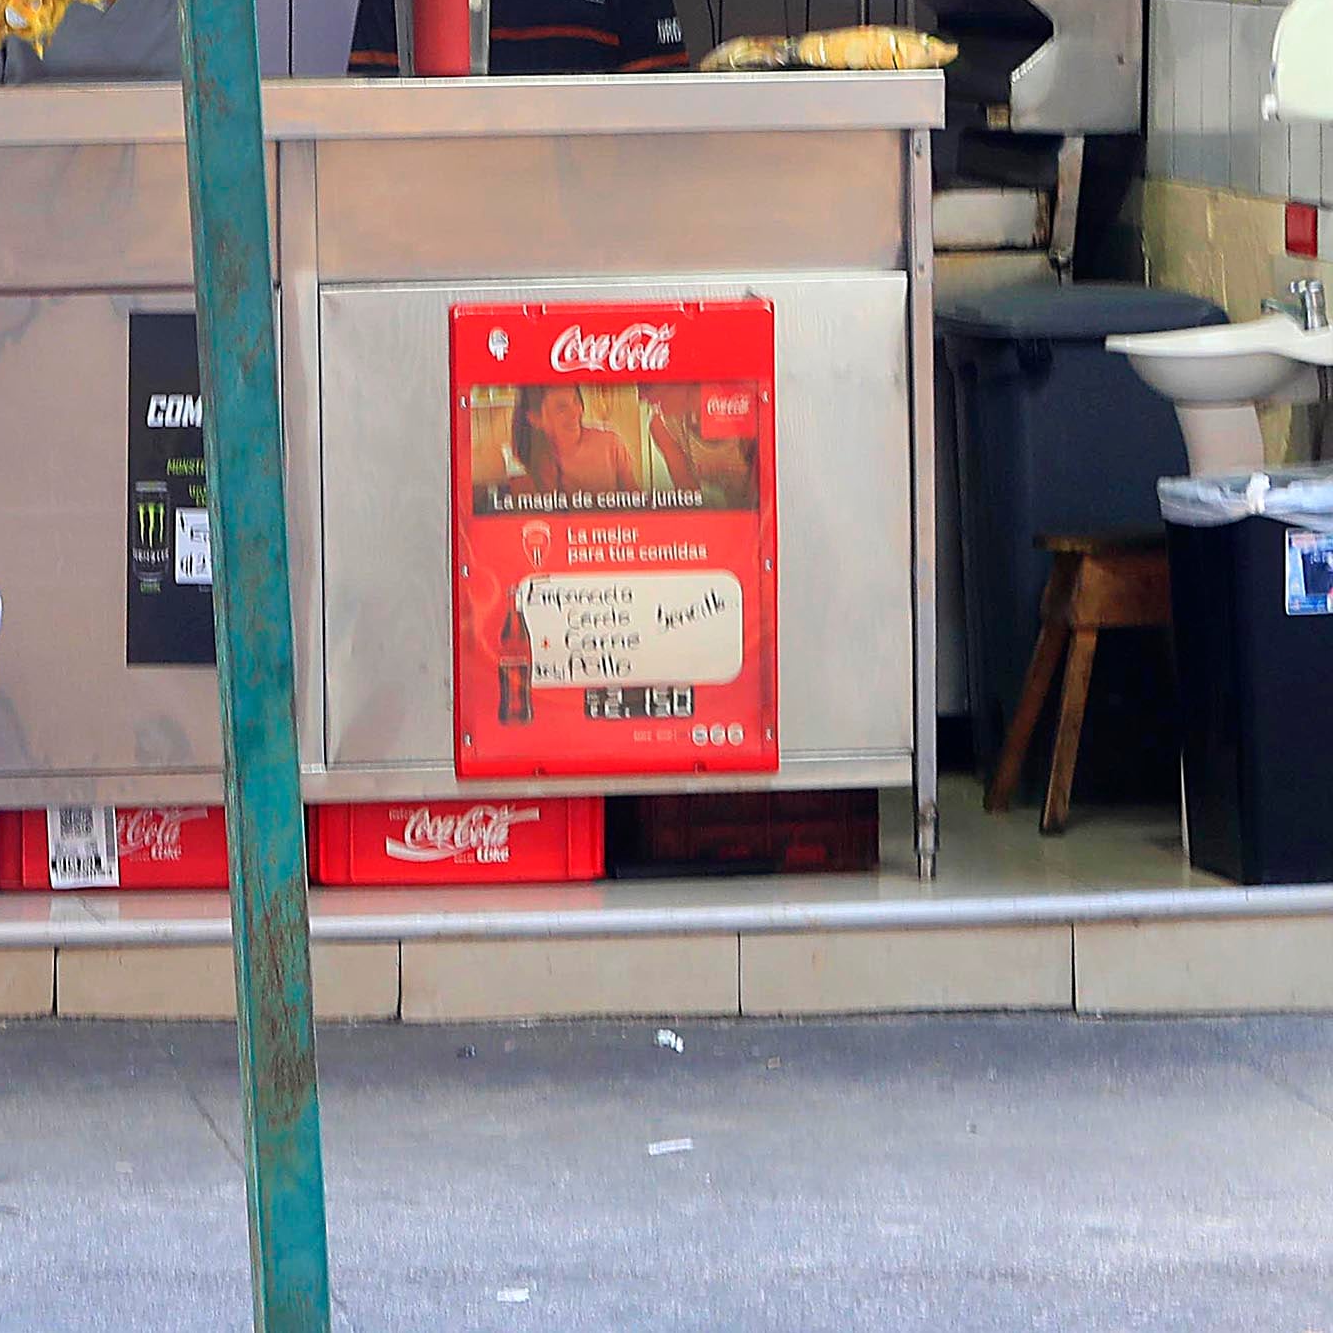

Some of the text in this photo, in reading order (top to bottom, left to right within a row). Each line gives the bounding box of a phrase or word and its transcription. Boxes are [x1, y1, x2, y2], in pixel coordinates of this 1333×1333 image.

[550, 323, 676, 373] Coca-Cola
[493, 489, 704, 513] La magia de comer juntos
[566, 526, 589, 545] La
[567, 542, 708, 565] para tus comidas
[403, 803, 517, 850] Coca-Cola
